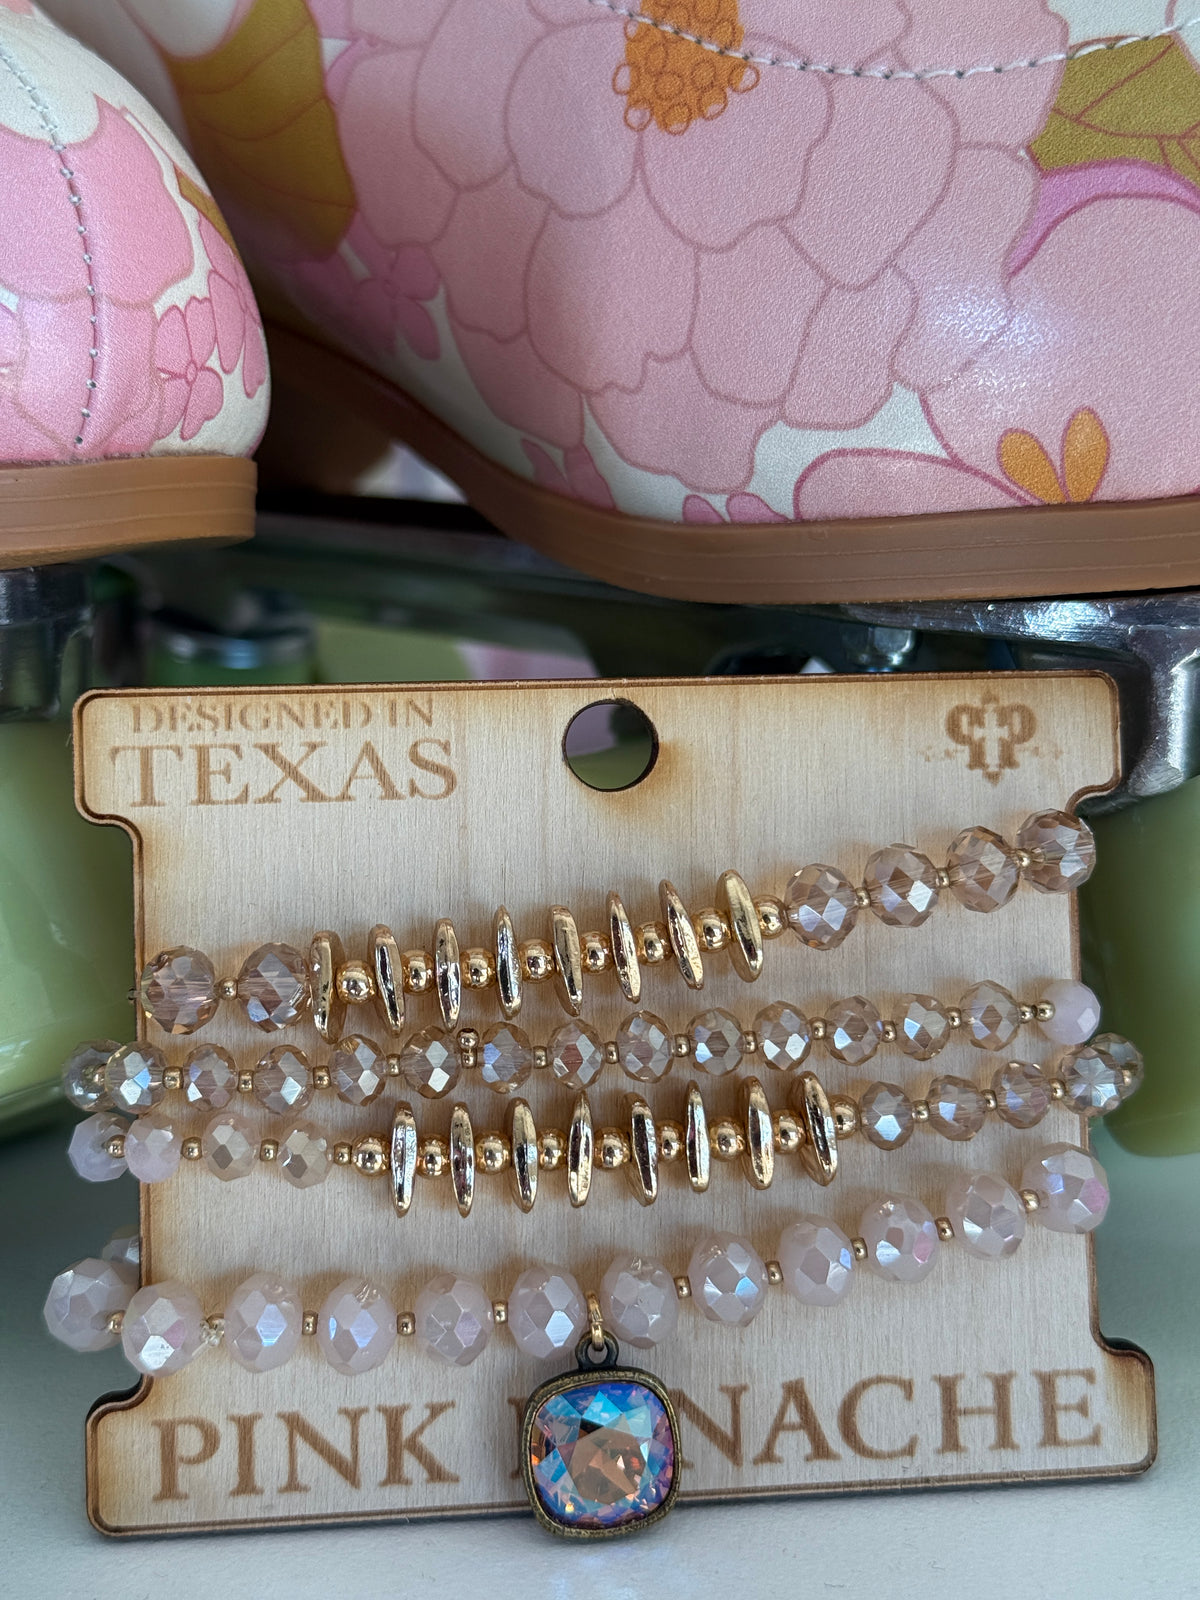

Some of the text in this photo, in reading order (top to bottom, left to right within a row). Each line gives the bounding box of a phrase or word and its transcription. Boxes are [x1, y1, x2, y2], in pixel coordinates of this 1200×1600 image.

[132, 698, 434, 733] DESIGNED IN
[110, 738, 458, 807] TEXAS
[151, 1367, 1102, 1502] PINK NACHE
